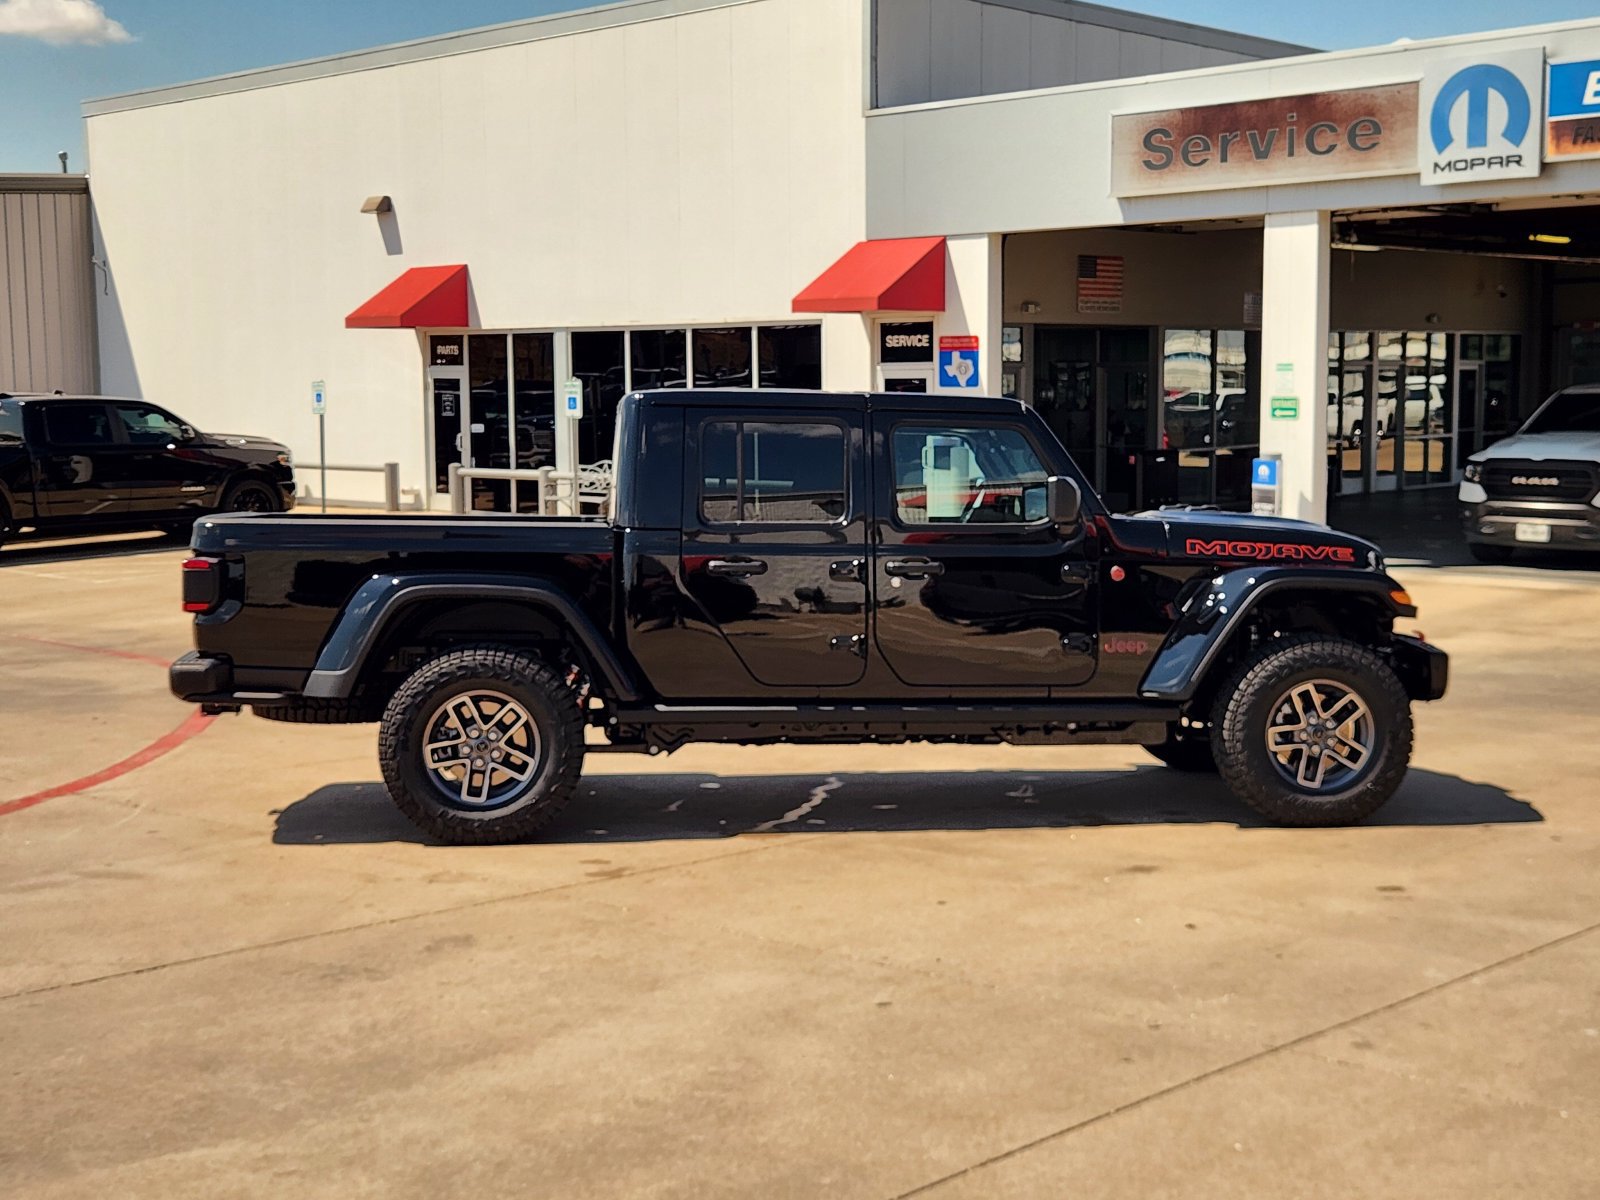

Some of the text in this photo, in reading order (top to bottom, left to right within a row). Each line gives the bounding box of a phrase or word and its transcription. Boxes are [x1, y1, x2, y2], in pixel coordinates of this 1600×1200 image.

[1141, 113, 1383, 172] Service
[1571, 123, 1600, 145] FA
[1433, 154, 1524, 174] MOPAR
[436, 345, 459, 355] PARTS
[885, 334, 930, 348] SERVICE
[1186, 538, 1355, 562] MOJAVE
[1104, 637, 1148, 656] Jeep
